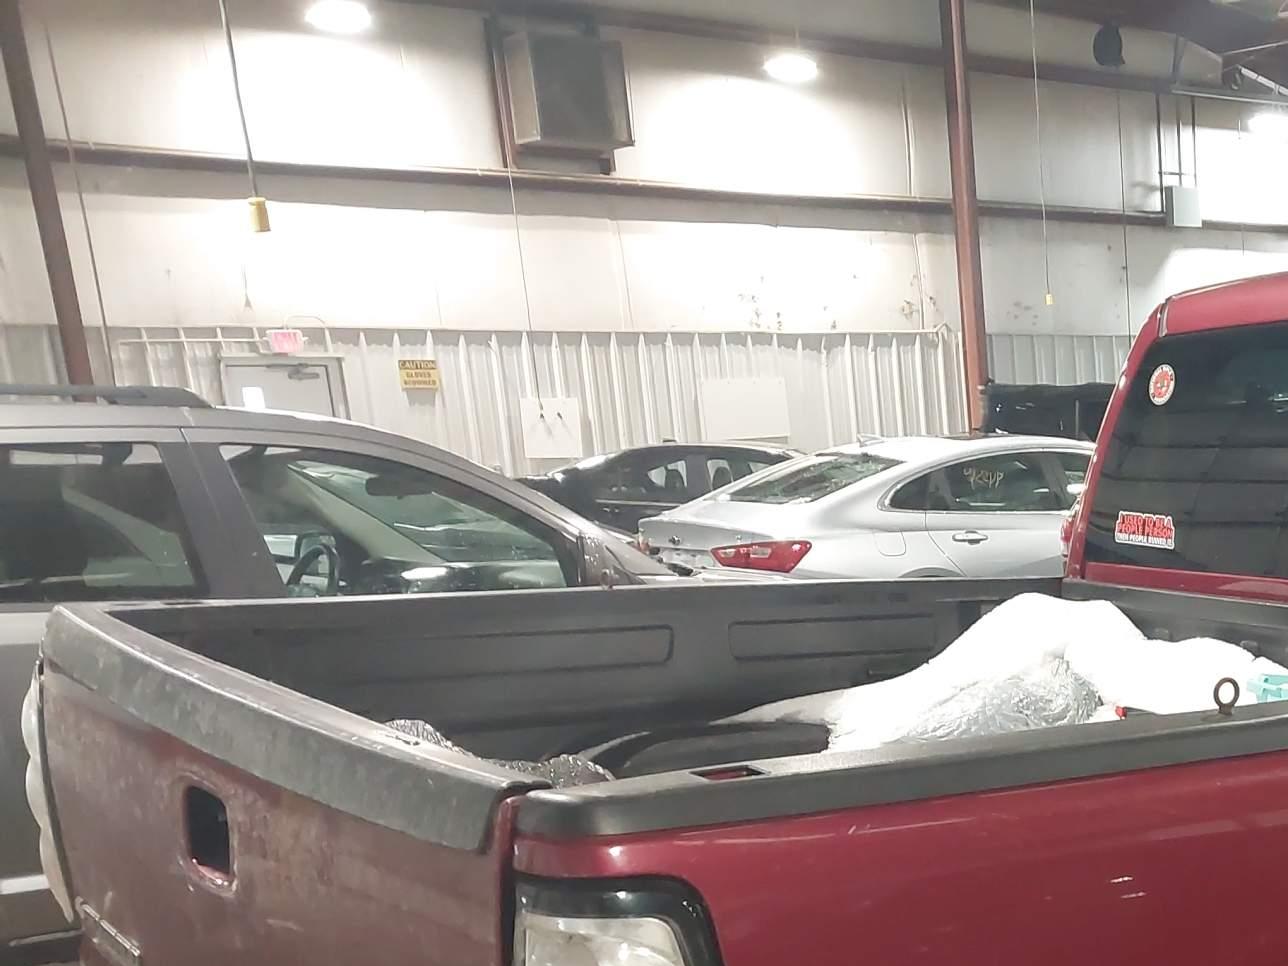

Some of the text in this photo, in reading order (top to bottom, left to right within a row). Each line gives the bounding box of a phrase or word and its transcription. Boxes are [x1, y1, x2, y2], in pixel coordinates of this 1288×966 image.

[400, 361, 435, 369] CAUTION
[1124, 515, 1143, 526] USED
[1145, 517, 1154, 526] TO
[1117, 523, 1174, 538] PEOPLE PERSON
